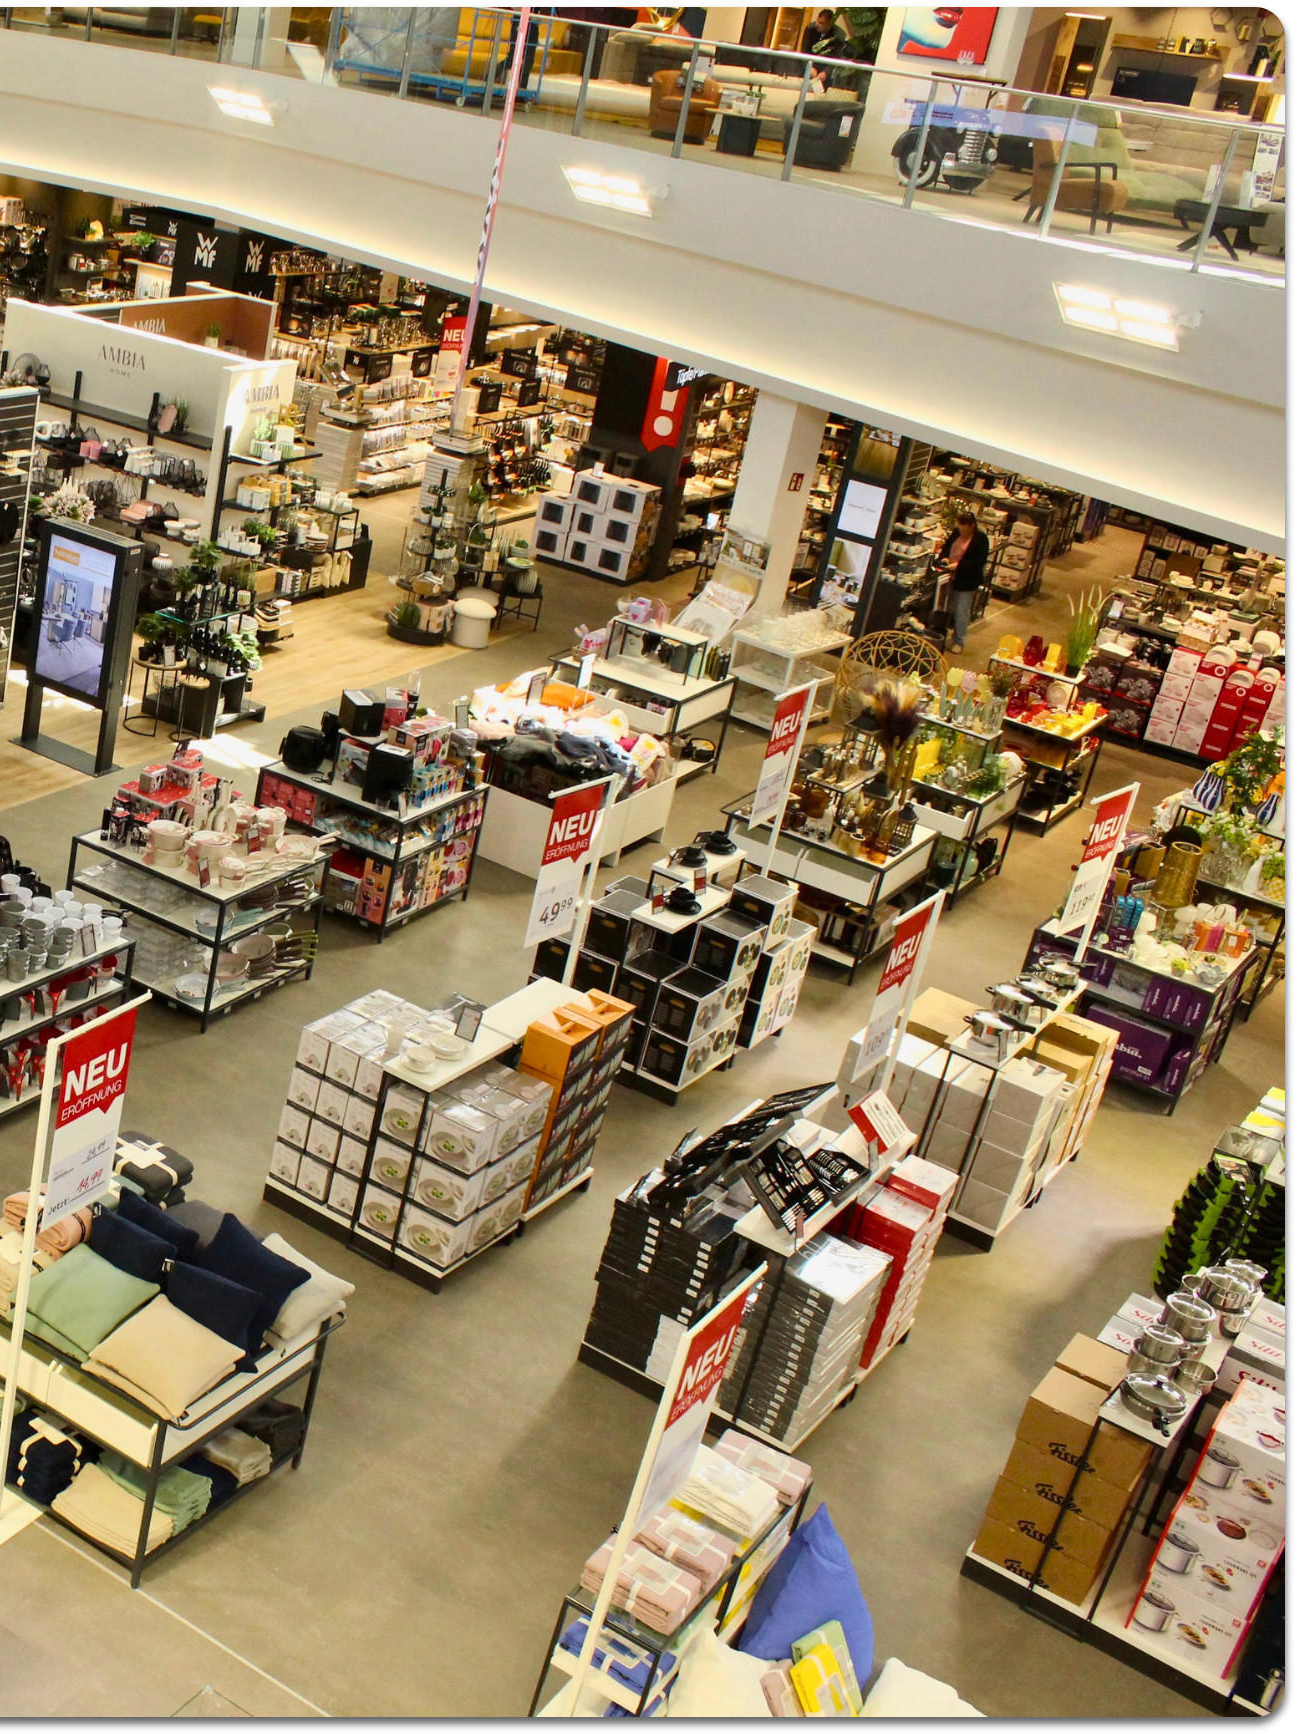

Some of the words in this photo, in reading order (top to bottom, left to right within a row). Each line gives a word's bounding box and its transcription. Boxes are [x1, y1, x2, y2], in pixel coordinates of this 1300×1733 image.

[100, 344, 146, 371] AMBIA
[770, 710, 802, 742] NEU
[549, 809, 595, 846] NEU
[1089, 814, 1124, 846] NEU
[545, 838, 589, 861] ERÖFFNUNG
[885, 931, 922, 974] NEU
[64, 1042, 128, 1103] NEU
[61, 1079, 122, 1121] ERÖFFNUNG
[677, 1324, 737, 1401] NEU
[670, 1365, 723, 1421] ERÖFFNUNG
[1035, 1483, 1083, 1514] Fisser
[1017, 1520, 1064, 1551] Fisser
[1003, 1558, 1050, 1589] Fisser
